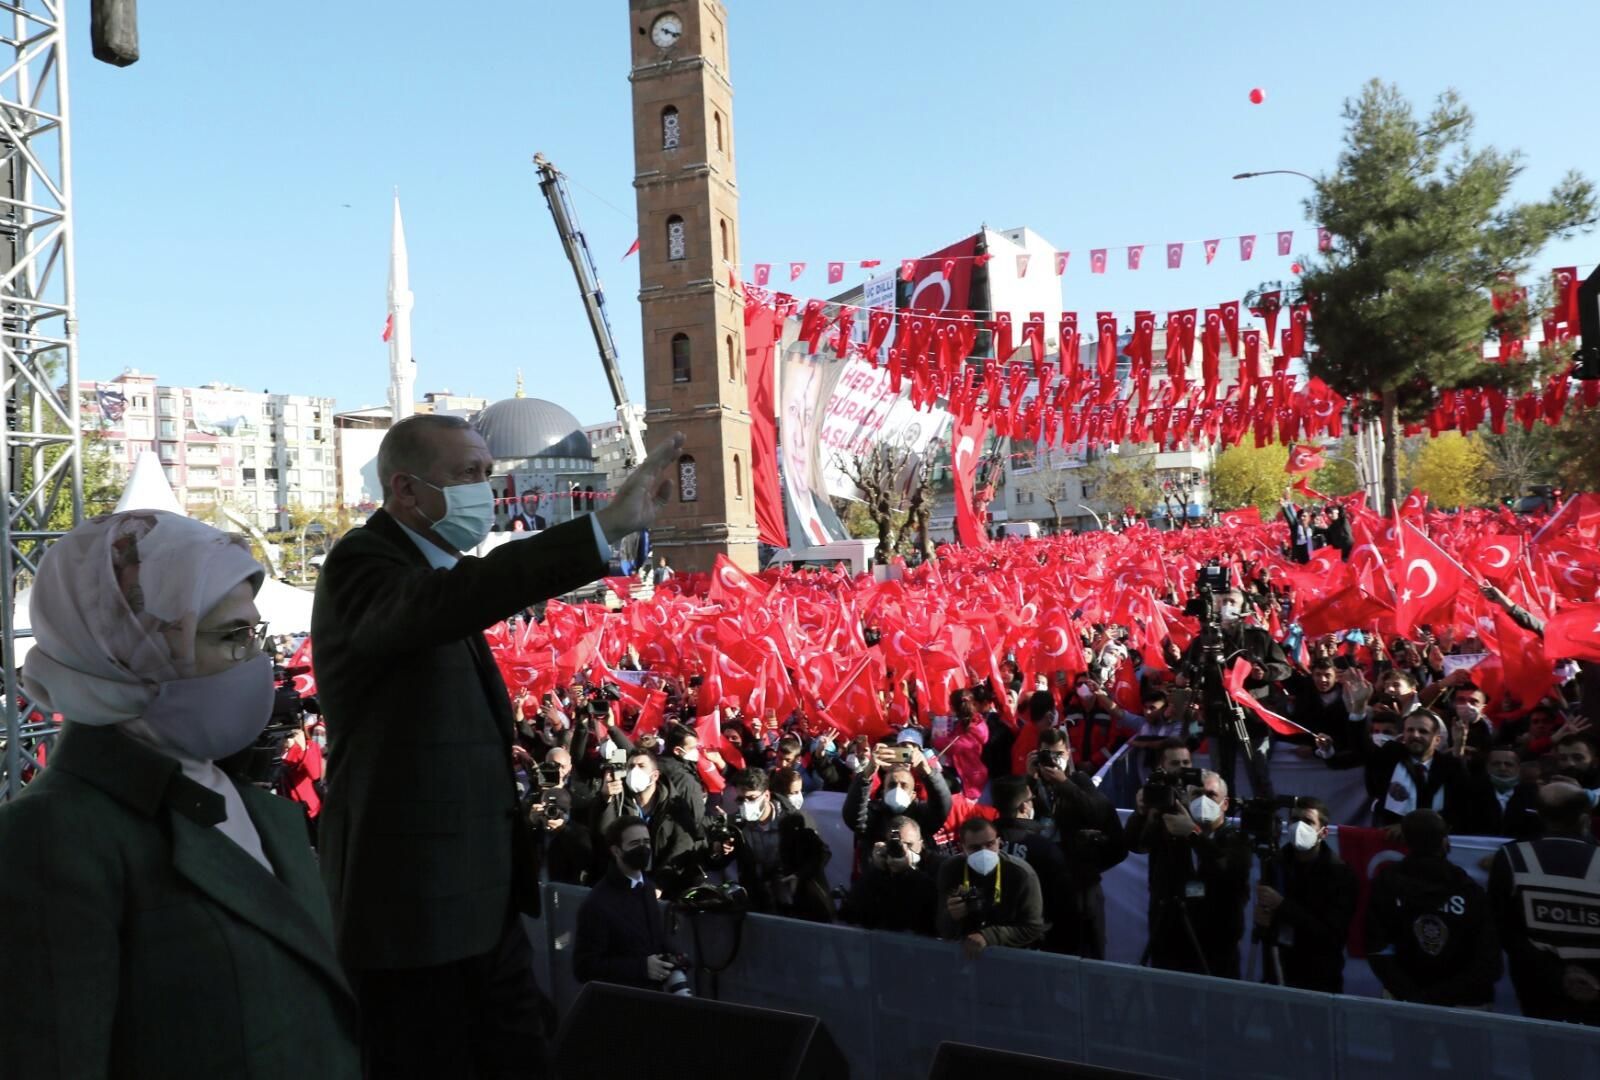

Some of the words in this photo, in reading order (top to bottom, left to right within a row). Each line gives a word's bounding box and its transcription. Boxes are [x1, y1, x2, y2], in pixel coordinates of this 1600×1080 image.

[840, 368, 875, 395] HER
[825, 393, 886, 431] BURADA
[1536, 905, 1600, 925] POLİS
